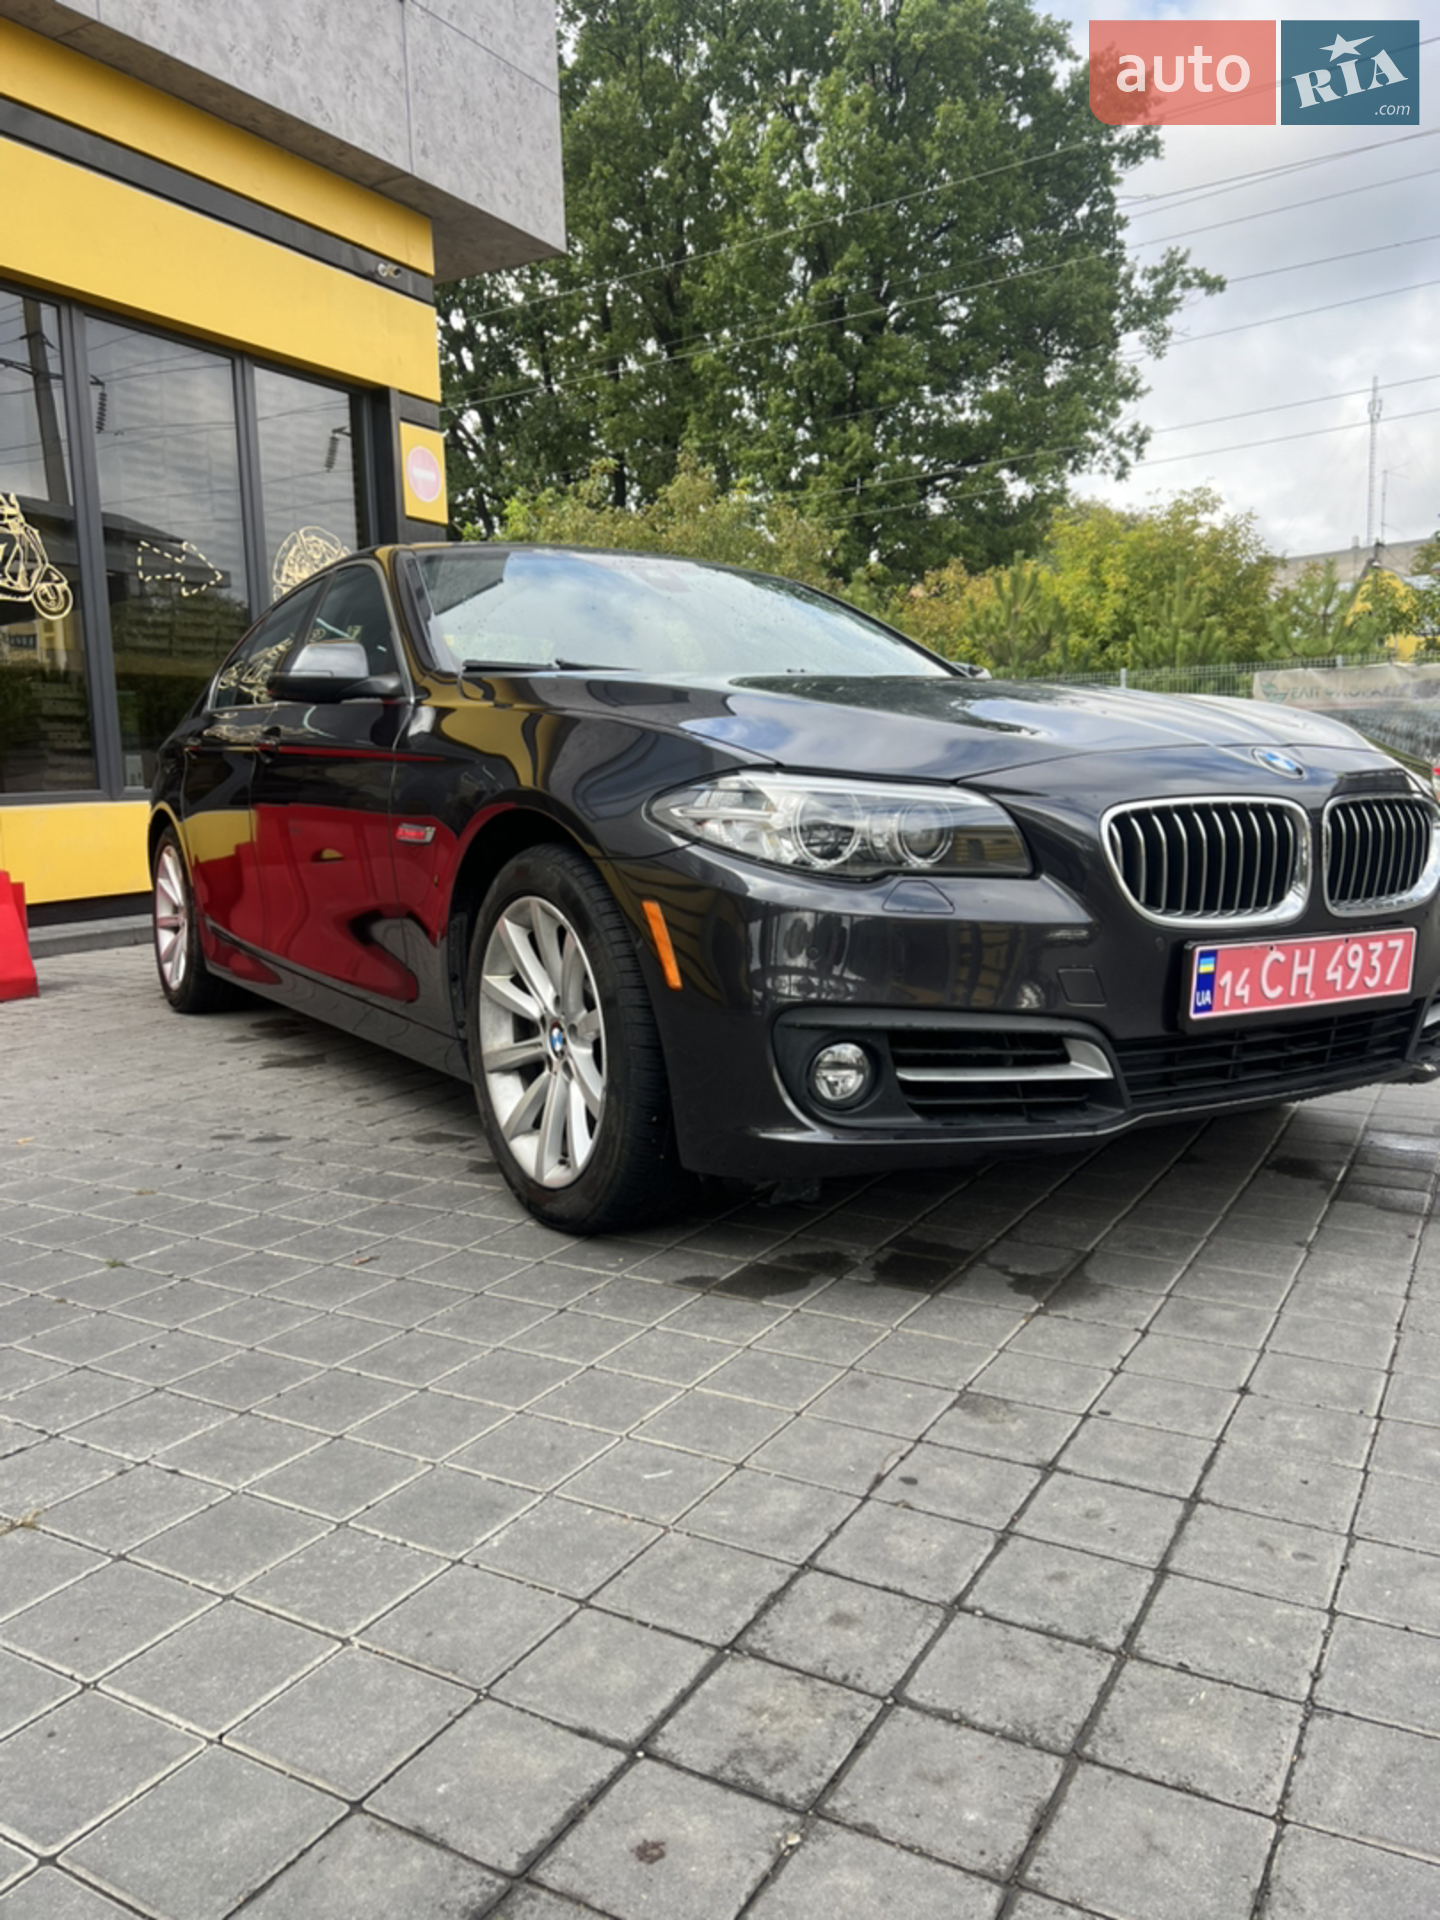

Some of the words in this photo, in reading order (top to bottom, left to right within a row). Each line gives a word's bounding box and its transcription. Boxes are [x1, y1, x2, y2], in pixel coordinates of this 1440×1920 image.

[1219, 968, 1251, 1007] 14
[1260, 948, 1316, 998] CH
[1325, 939, 1405, 992] 4937
[1195, 989, 1212, 1007] UA
